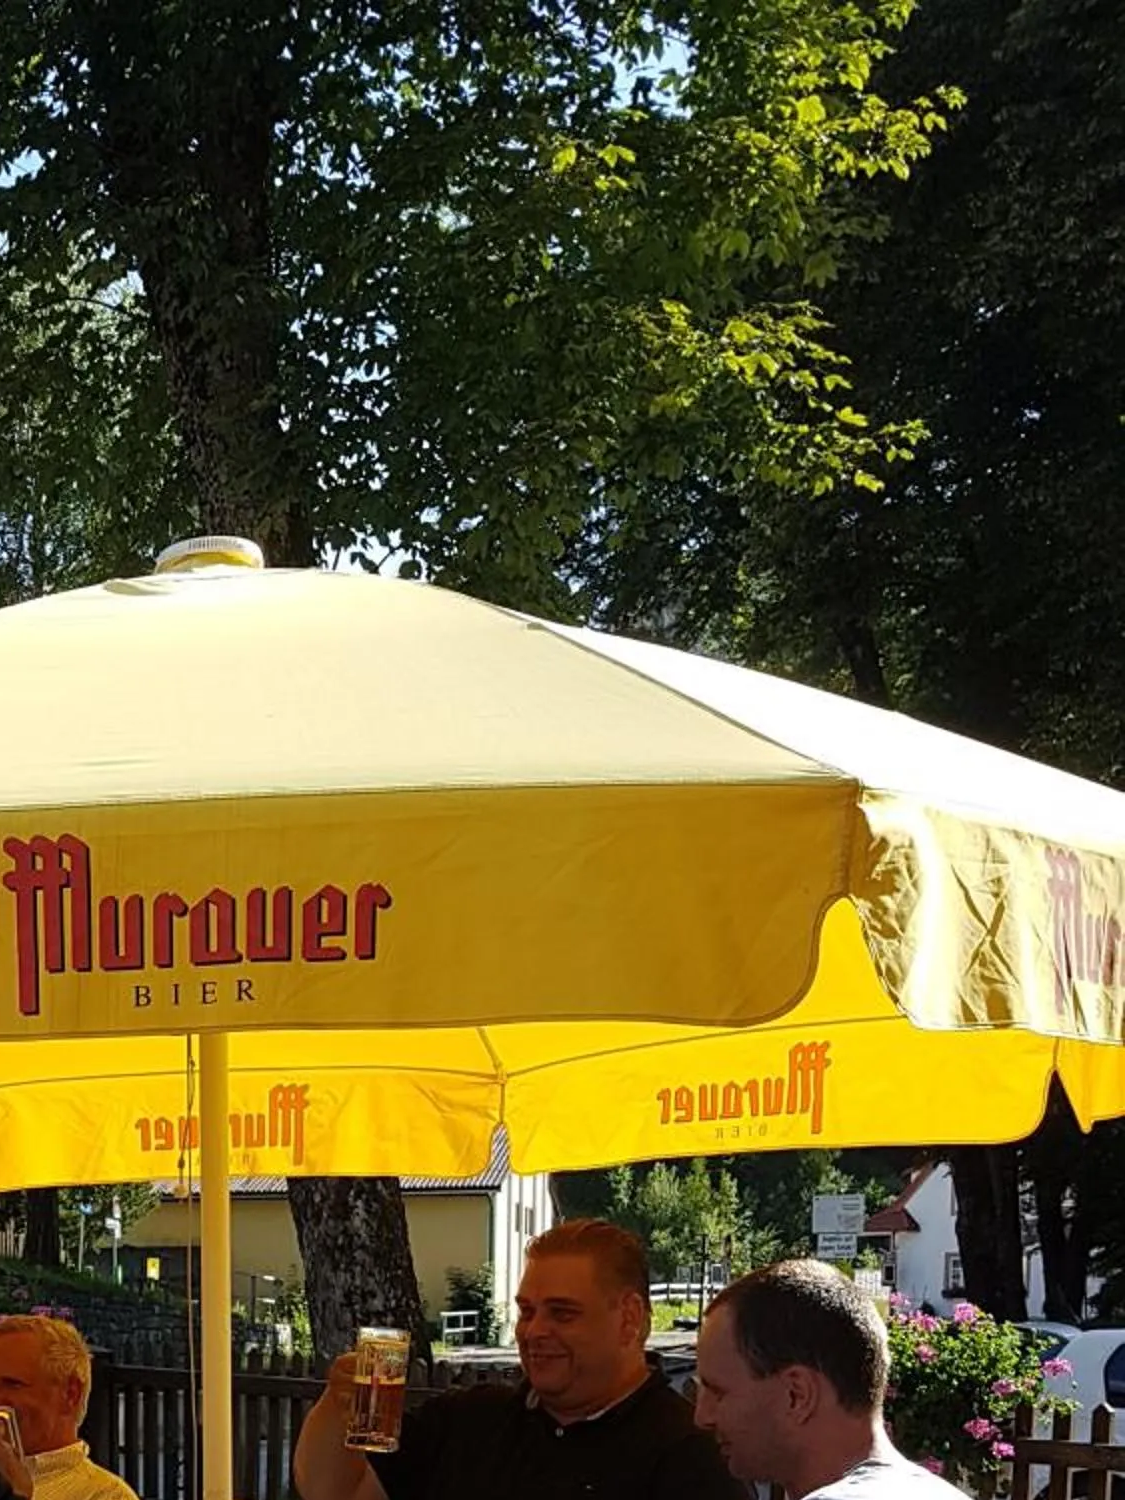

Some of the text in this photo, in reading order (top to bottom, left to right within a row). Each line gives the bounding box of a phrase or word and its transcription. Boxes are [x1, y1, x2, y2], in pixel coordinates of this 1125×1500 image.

[3, 833, 393, 1016] Murauer
[132, 979, 257, 1007] BIER
[1044, 844, 1125, 1016] Mur
